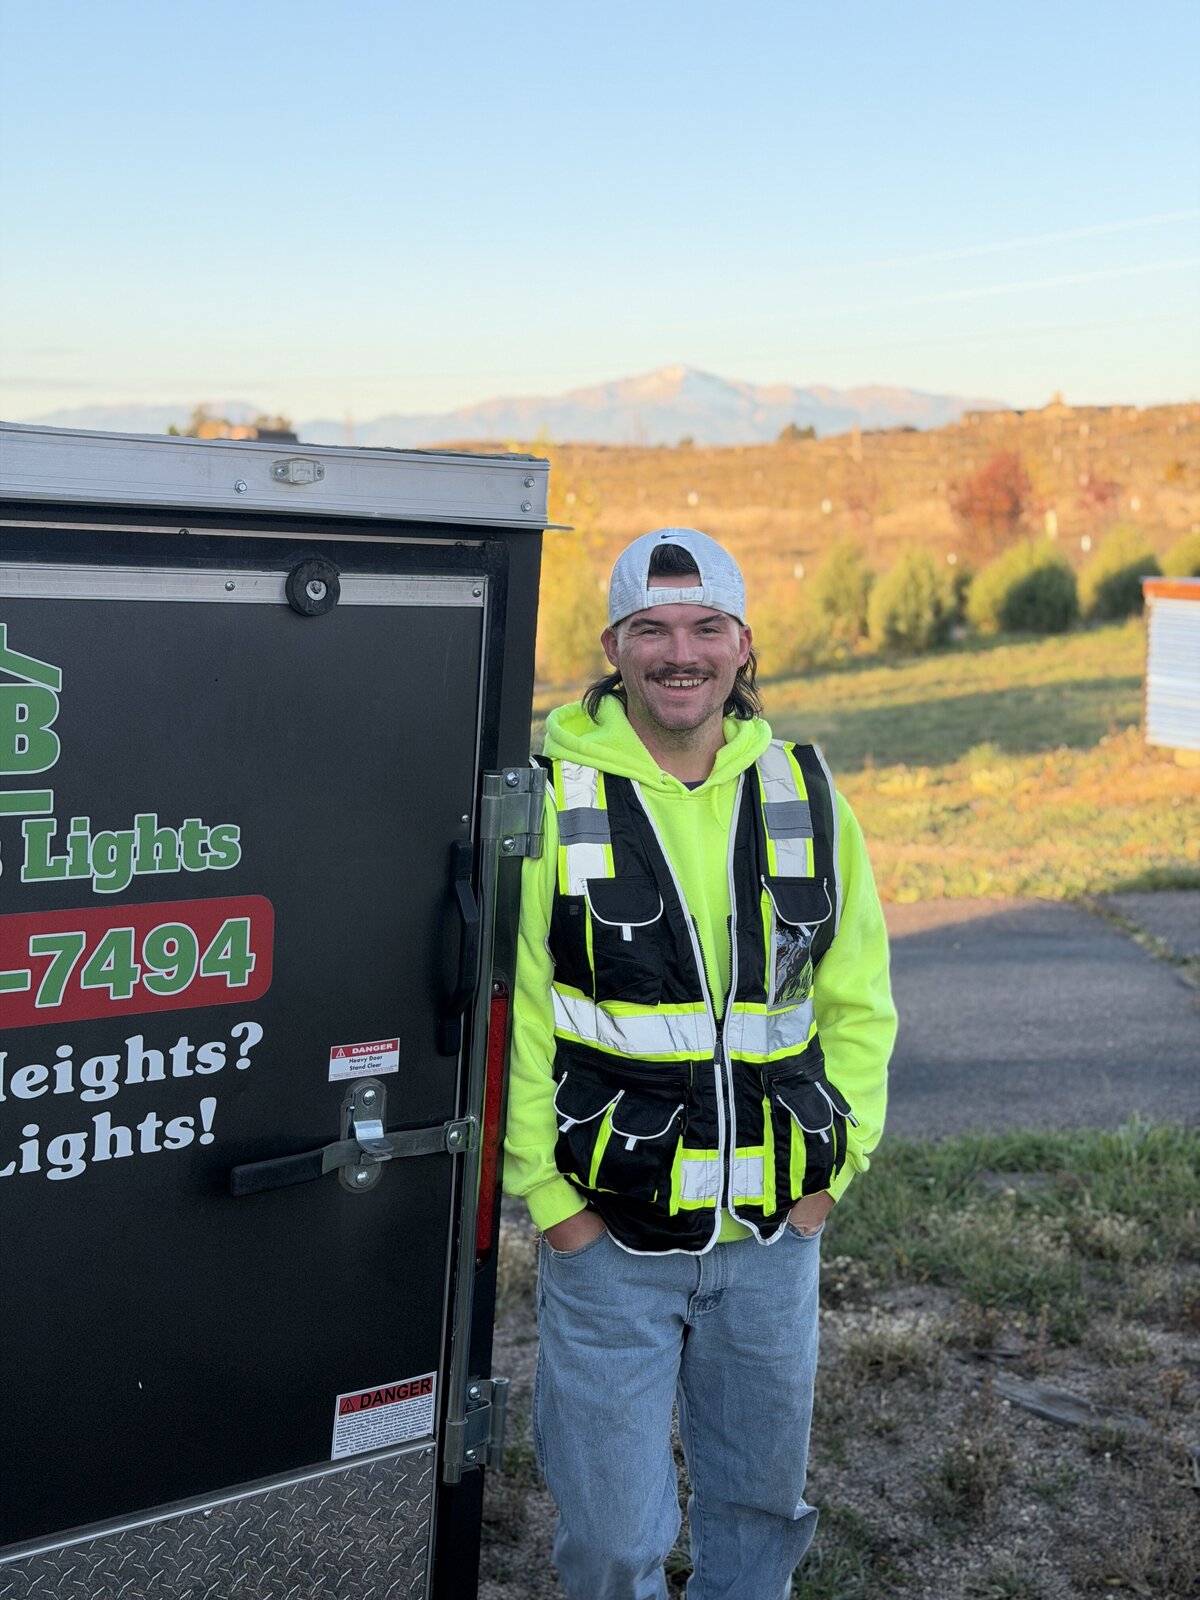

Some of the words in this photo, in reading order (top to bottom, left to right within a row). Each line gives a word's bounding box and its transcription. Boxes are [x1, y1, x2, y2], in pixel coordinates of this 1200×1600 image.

[21, 813, 242, 894] Lights
[0, 1022, 264, 1102] eights?
[352, 1043, 393, 1054] DANGER
[360, 1378, 431, 1409] DANGER
